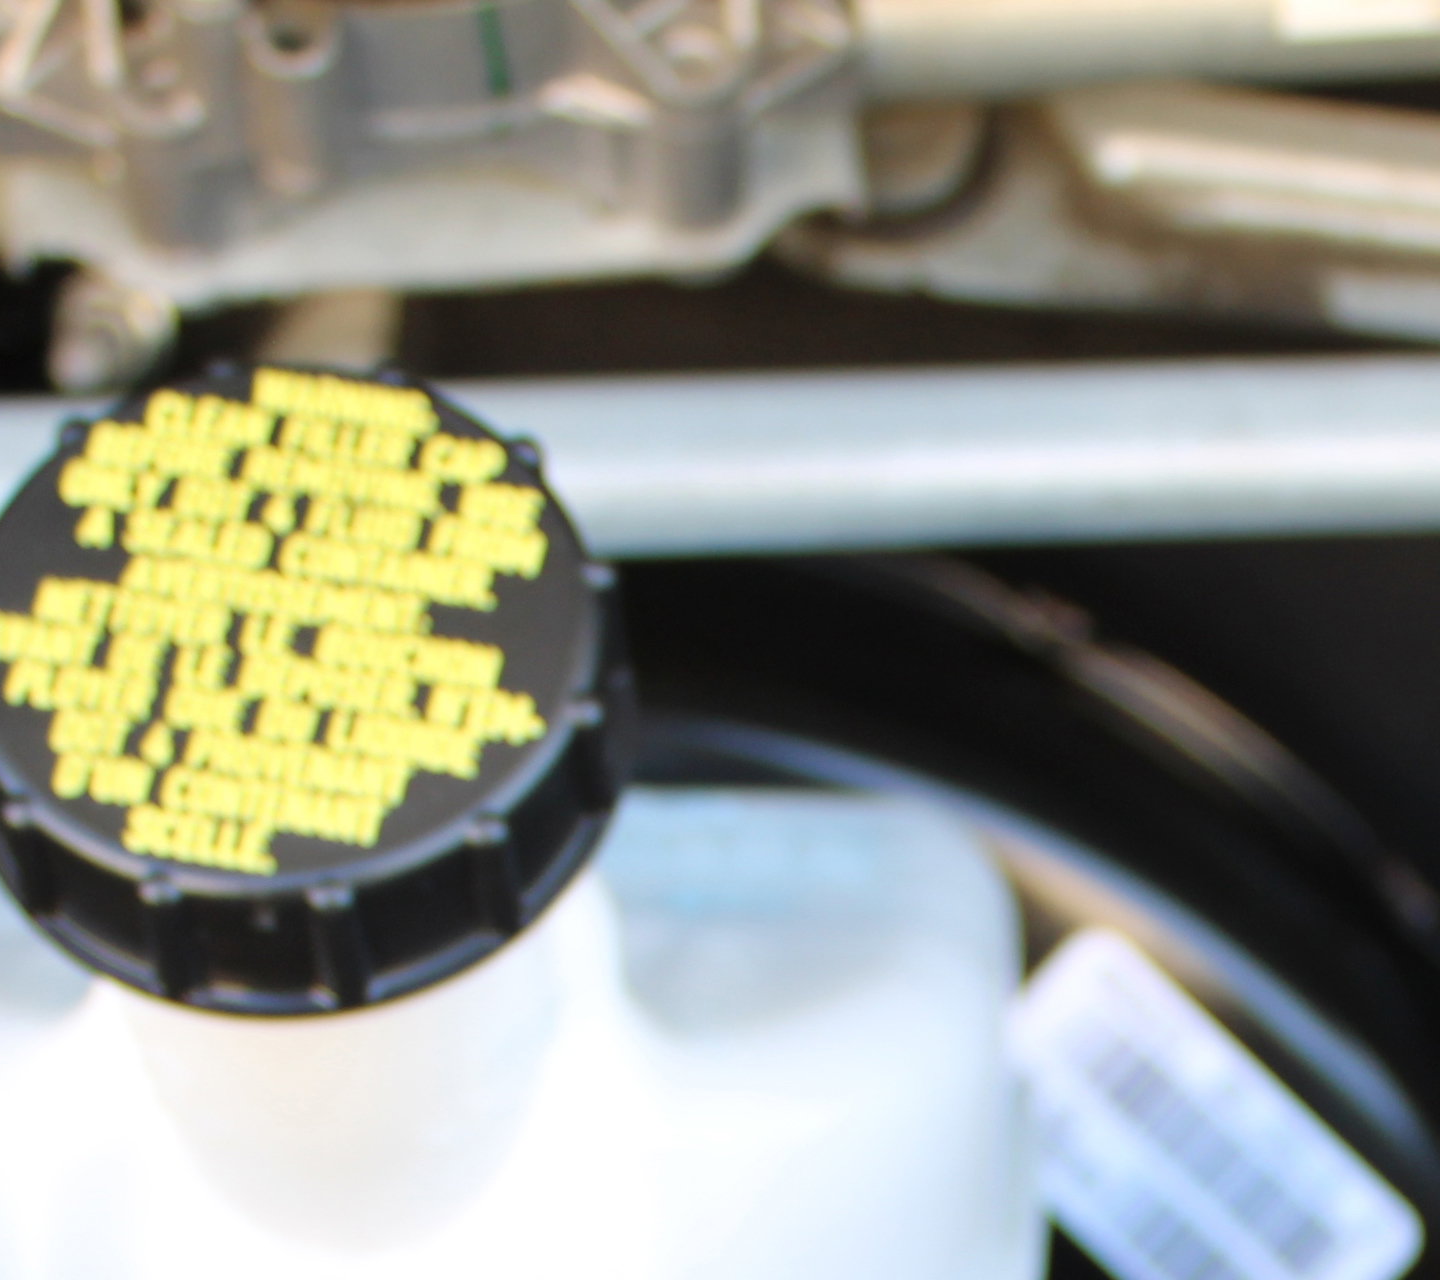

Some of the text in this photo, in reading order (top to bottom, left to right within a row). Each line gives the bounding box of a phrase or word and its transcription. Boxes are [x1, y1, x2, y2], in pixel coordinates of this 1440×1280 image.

[85, 419, 232, 480] BEFORE
[145, 388, 508, 486] CLEAN FILLER CAP
[58, 454, 172, 513] ONLY
[171, 474, 254, 524] DOT
[303, 493, 424, 552] FLUID
[428, 511, 549, 580] FROM
[74, 504, 114, 550] A
[120, 507, 274, 572] SEALED
[239, 606, 296, 657] LE
[173, 641, 236, 693] LE
[48, 707, 134, 760] DOT
[164, 685, 251, 738] QUE
[254, 697, 323, 747] DU
